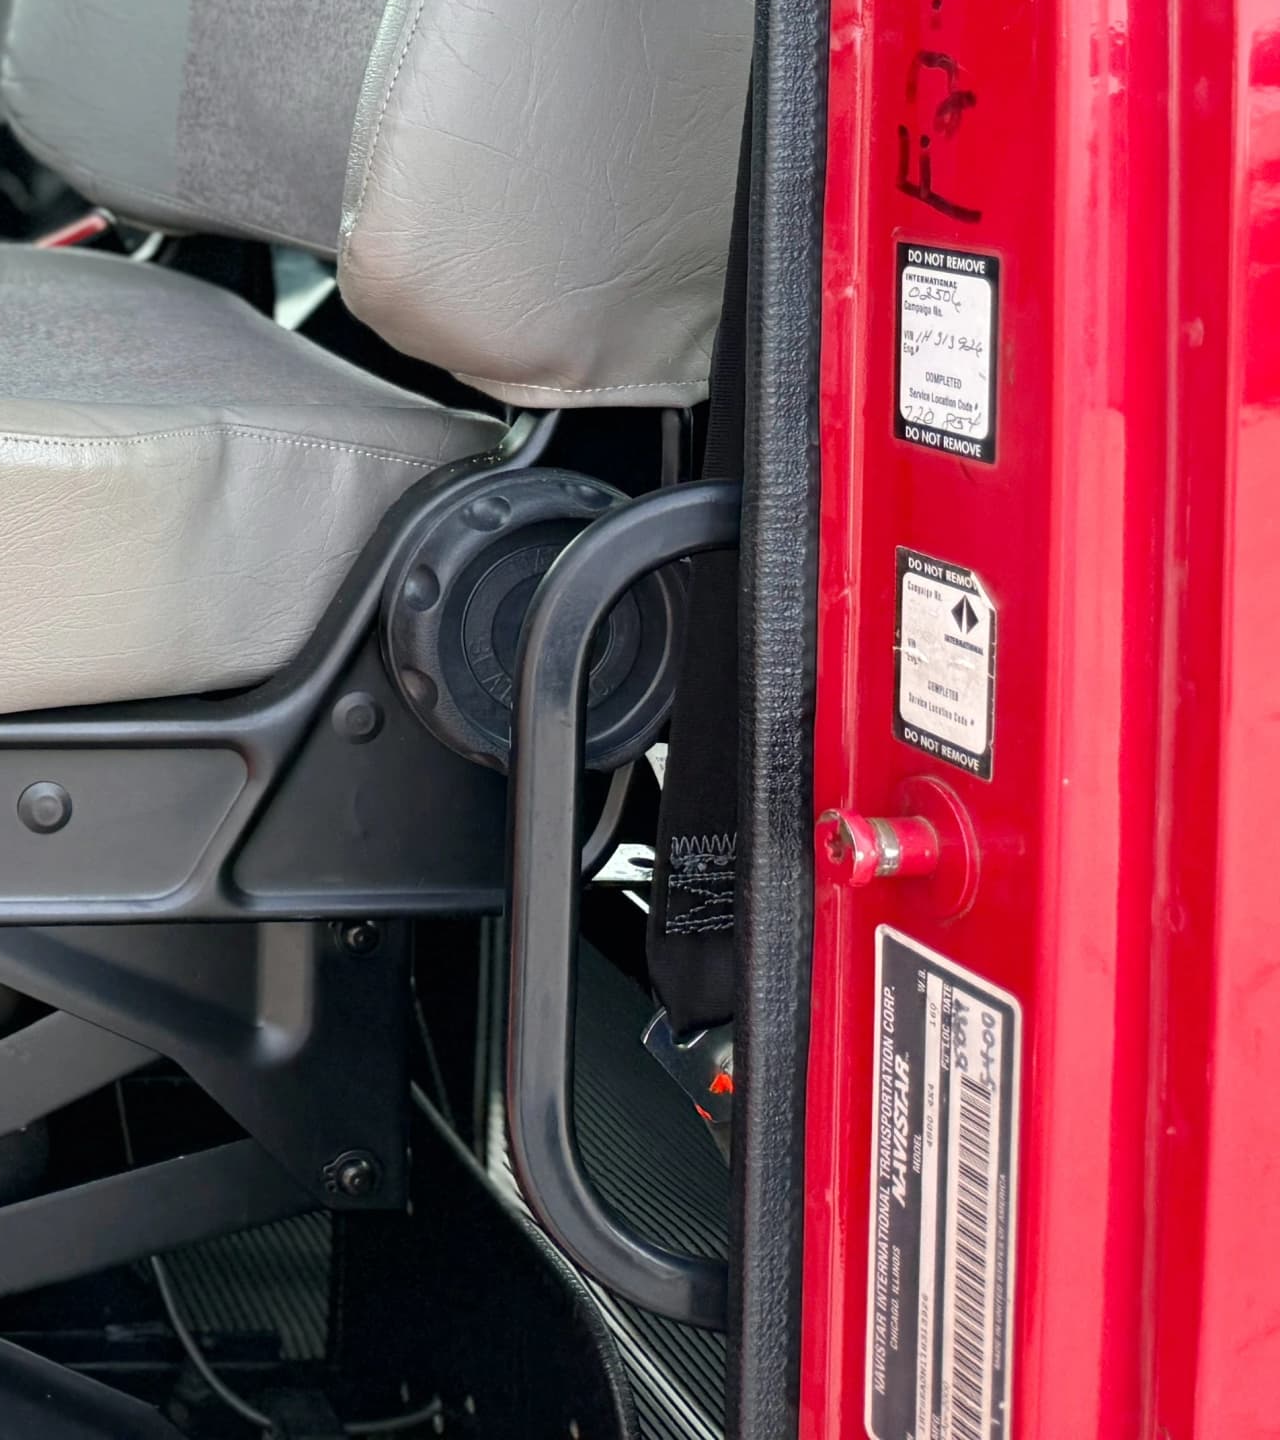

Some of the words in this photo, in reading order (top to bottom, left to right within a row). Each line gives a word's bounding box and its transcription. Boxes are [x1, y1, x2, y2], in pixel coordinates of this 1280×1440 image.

[908, 249, 922, 263] DO
[924, 251, 944, 267] NOT
[946, 255, 985, 274] REMOVE
[905, 273, 957, 289] INTERNATIONAL
[904, 300, 931, 316] Campaign
[904, 329, 913, 341] VIN
[925, 371, 961, 390] COMPLETED
[909, 387, 929, 401] Service
[931, 392, 956, 407] Location
[957, 398, 973, 412] Code
[905, 426, 919, 440] DO
[921, 430, 940, 446] NOT
[943, 436, 981, 457] REMOVE
[908, 556, 922, 572] DO
[924, 562, 942, 579] NOT
[904, 727, 917, 743] DO
[921, 734, 939, 753] NOT
[941, 744, 978, 771] REMOVE
[883, 984, 895, 1034] CORP.
[943, 982, 951, 1014] DATE
[879, 1035, 893, 1179] TRANSPORTATION
[891, 1053, 909, 1208] NAVISTAR
[912, 1132, 921, 1174] MODEL
[876, 1184, 890, 1311] INTERNATIONAL
[891, 1245, 900, 1294] ILLINOIS
[874, 1312, 886, 1395] NAVISTAR
